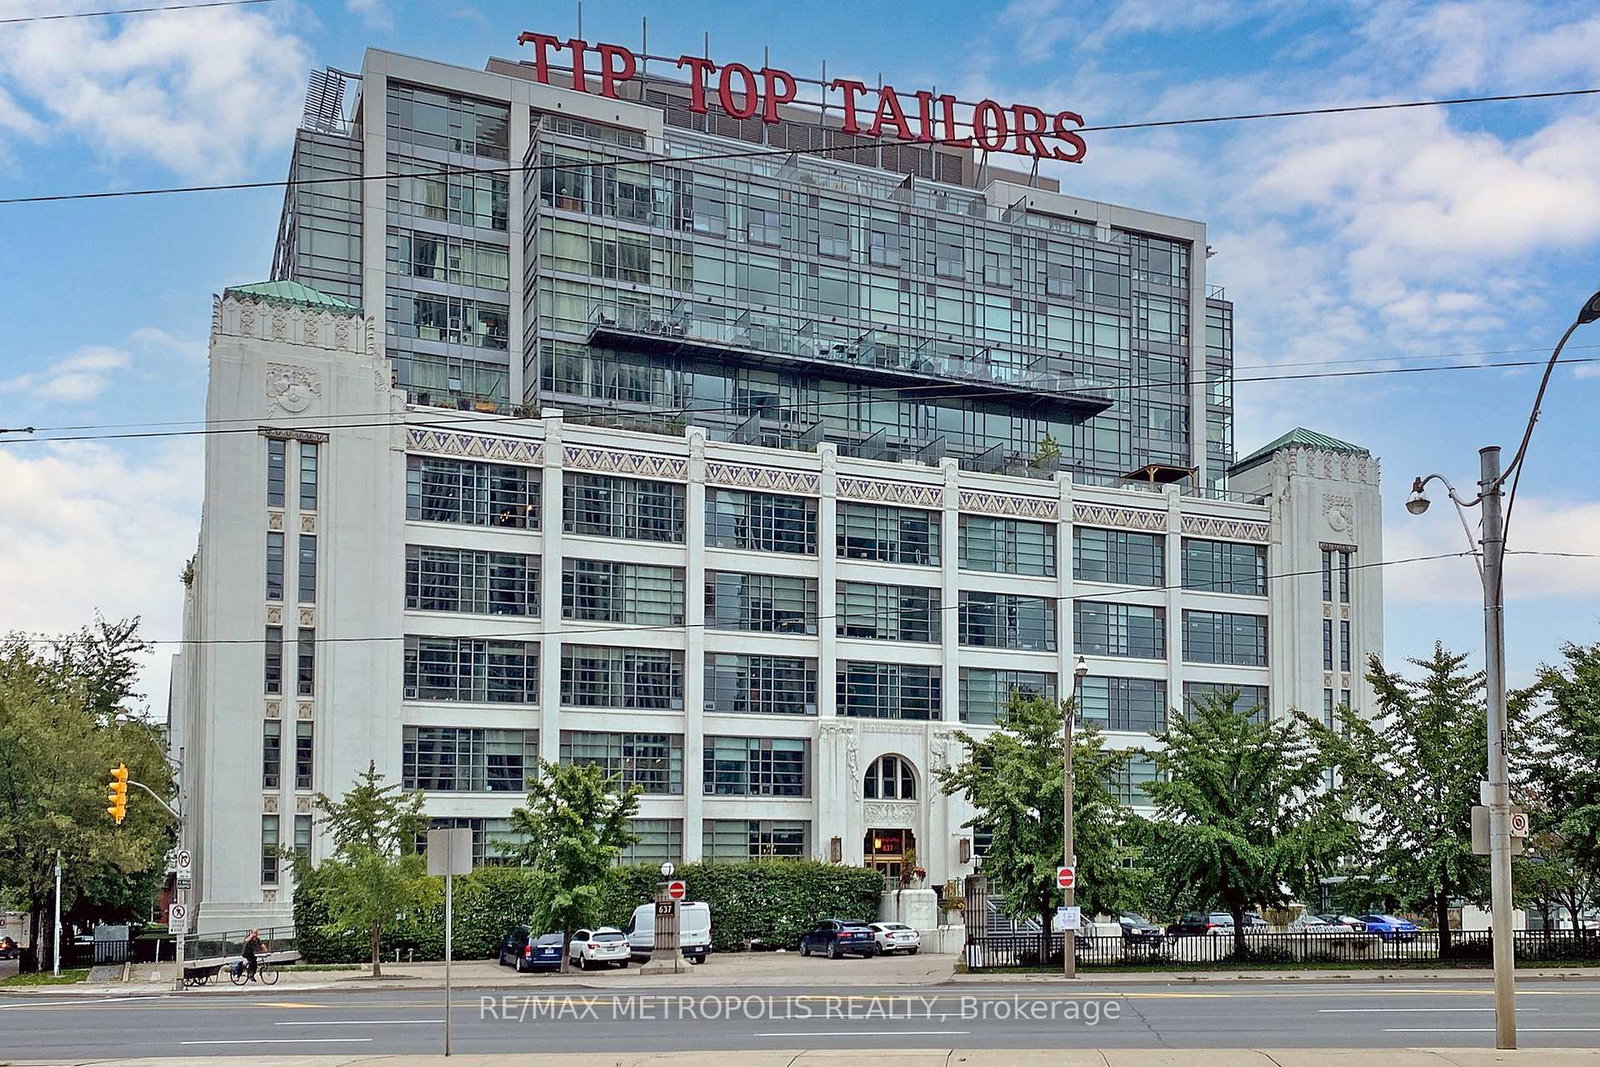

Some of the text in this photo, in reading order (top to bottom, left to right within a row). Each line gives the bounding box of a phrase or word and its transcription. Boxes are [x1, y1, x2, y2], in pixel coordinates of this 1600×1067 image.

[518, 31, 1087, 163] TIP TOP TAILORS
[658, 905, 673, 914] 637
